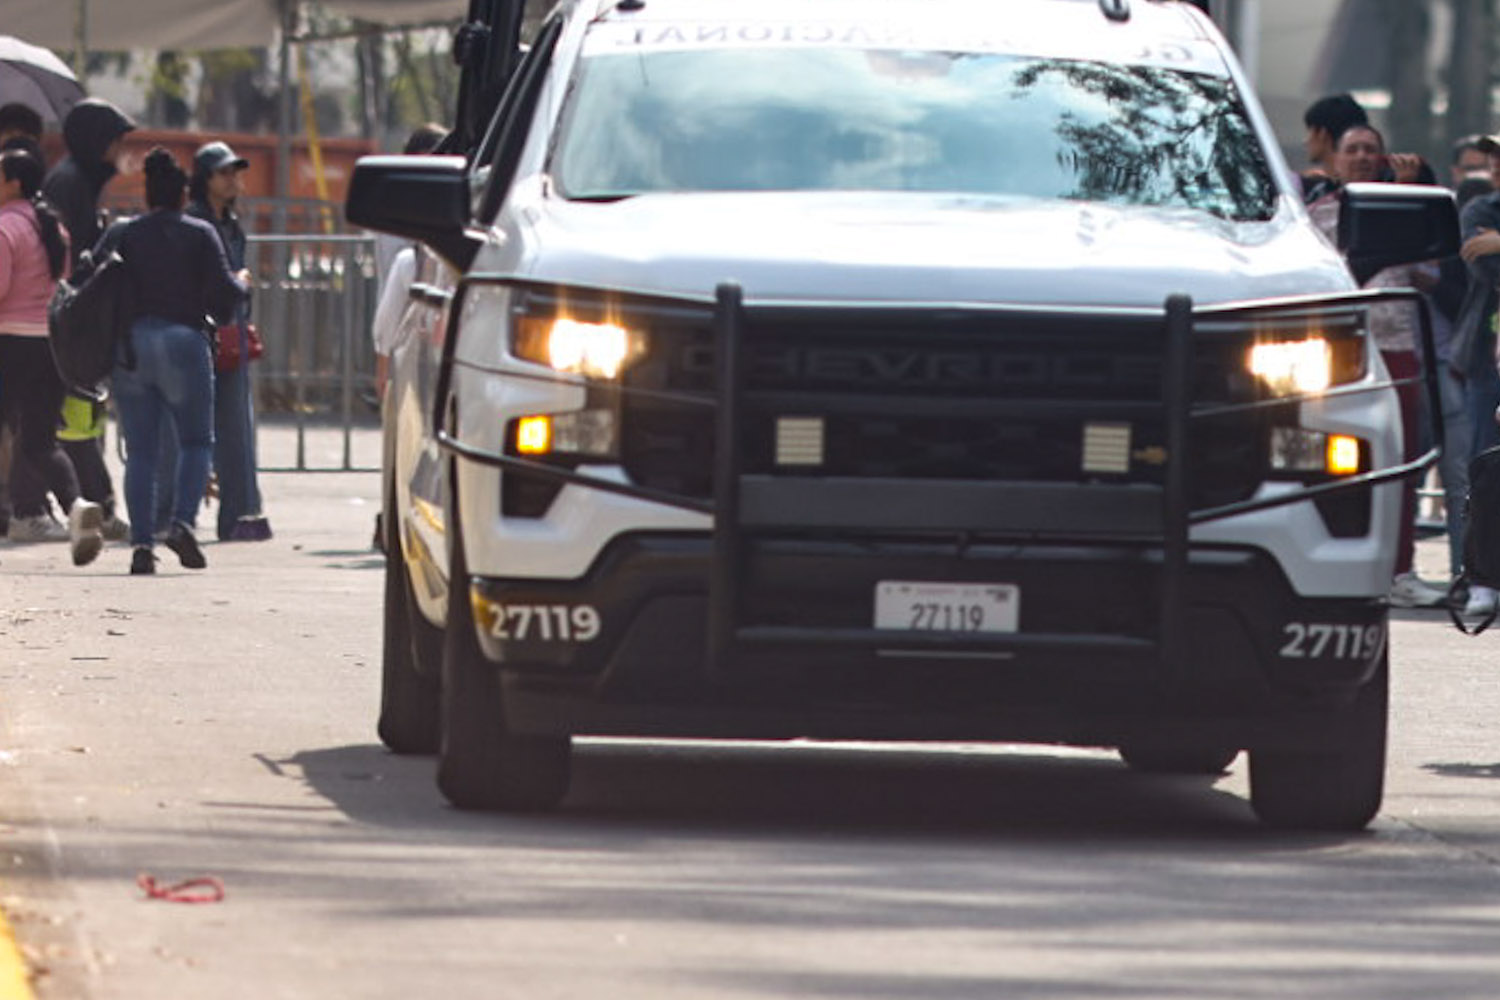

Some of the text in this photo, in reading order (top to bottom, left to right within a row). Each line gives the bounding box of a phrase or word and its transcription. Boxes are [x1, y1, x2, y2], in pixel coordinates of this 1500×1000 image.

[489, 605, 600, 642] 27119
[911, 603, 985, 630] 27119
[1279, 624, 1379, 660] 27119
